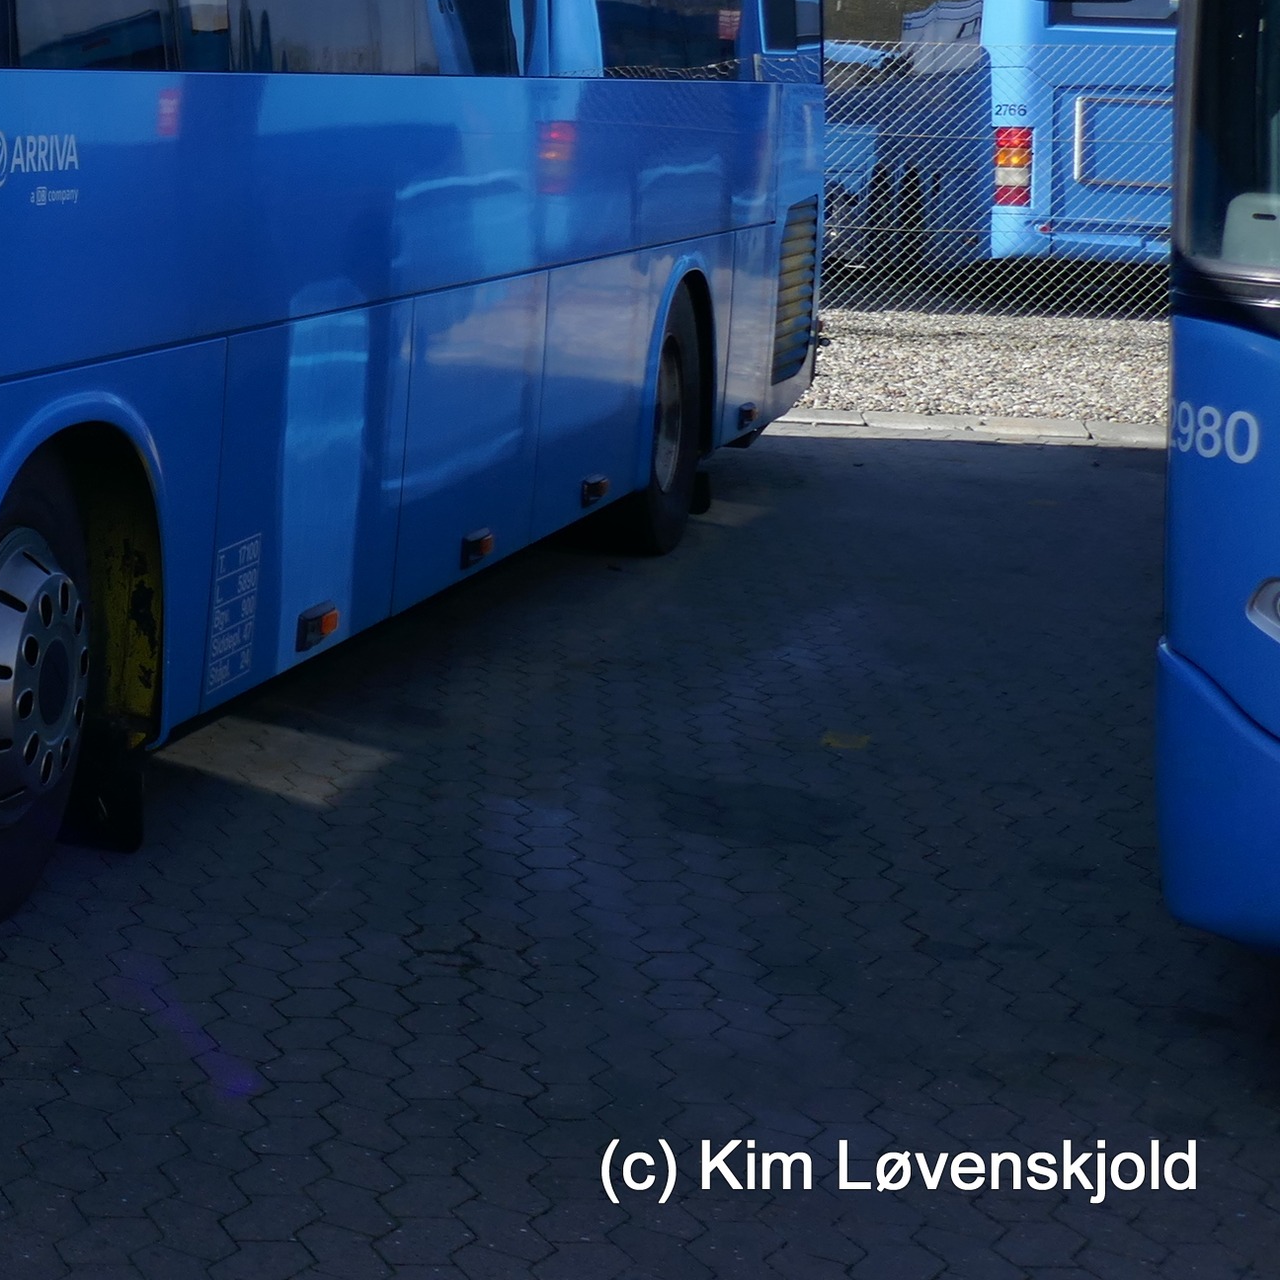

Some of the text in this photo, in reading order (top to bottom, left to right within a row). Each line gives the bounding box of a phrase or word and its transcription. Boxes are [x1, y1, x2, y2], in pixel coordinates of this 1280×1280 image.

[994, 103, 1027, 117] 2766
[9, 133, 79, 174] ARRIVA
[48, 189, 79, 205] company
